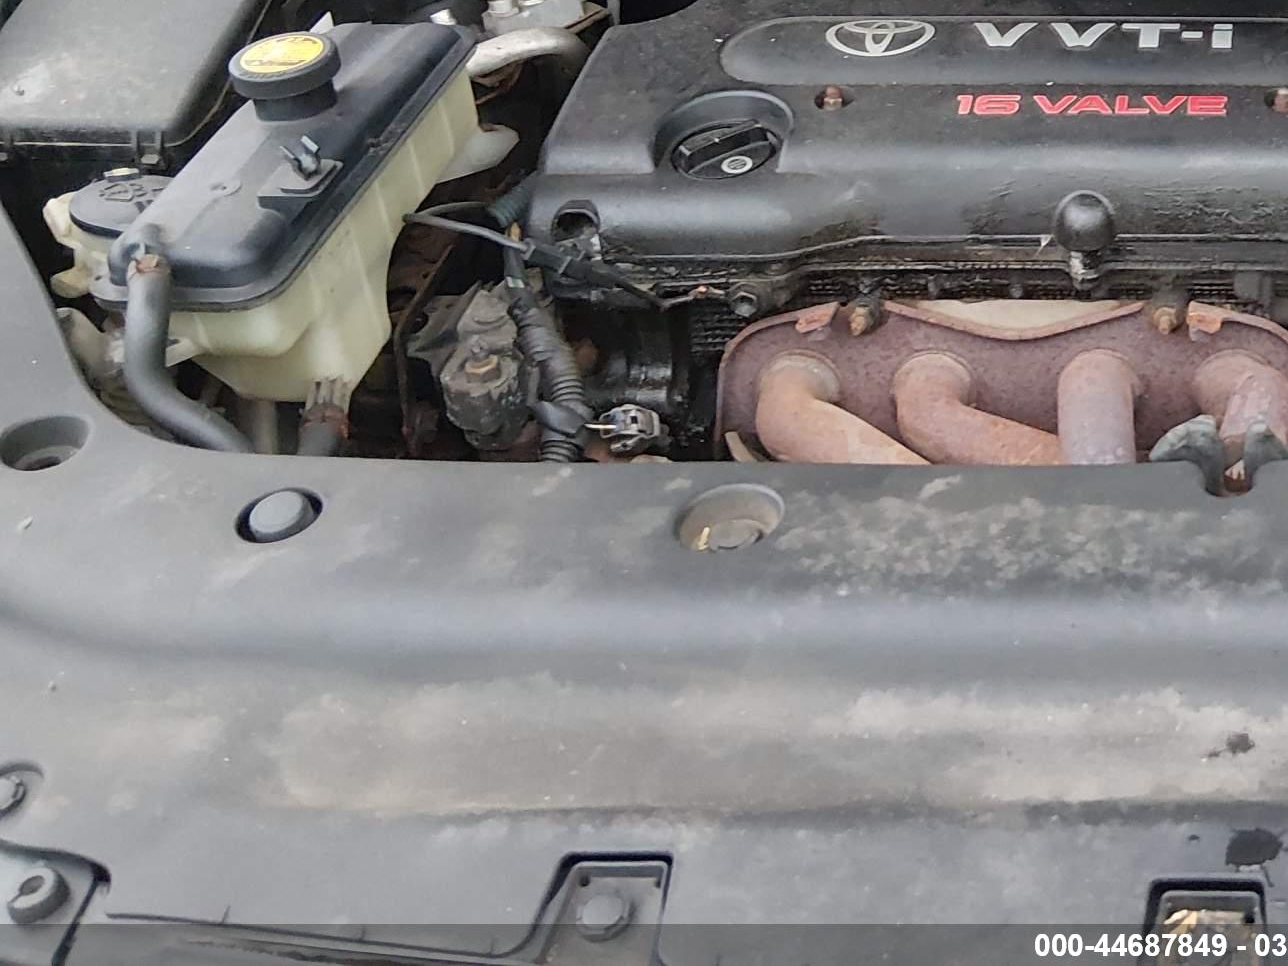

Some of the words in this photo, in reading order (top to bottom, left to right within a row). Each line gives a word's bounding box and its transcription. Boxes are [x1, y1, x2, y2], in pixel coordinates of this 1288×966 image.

[974, 22, 1234, 49] VVT-i
[956, 94, 1022, 115] 16
[1033, 94, 1229, 115] VALVE
